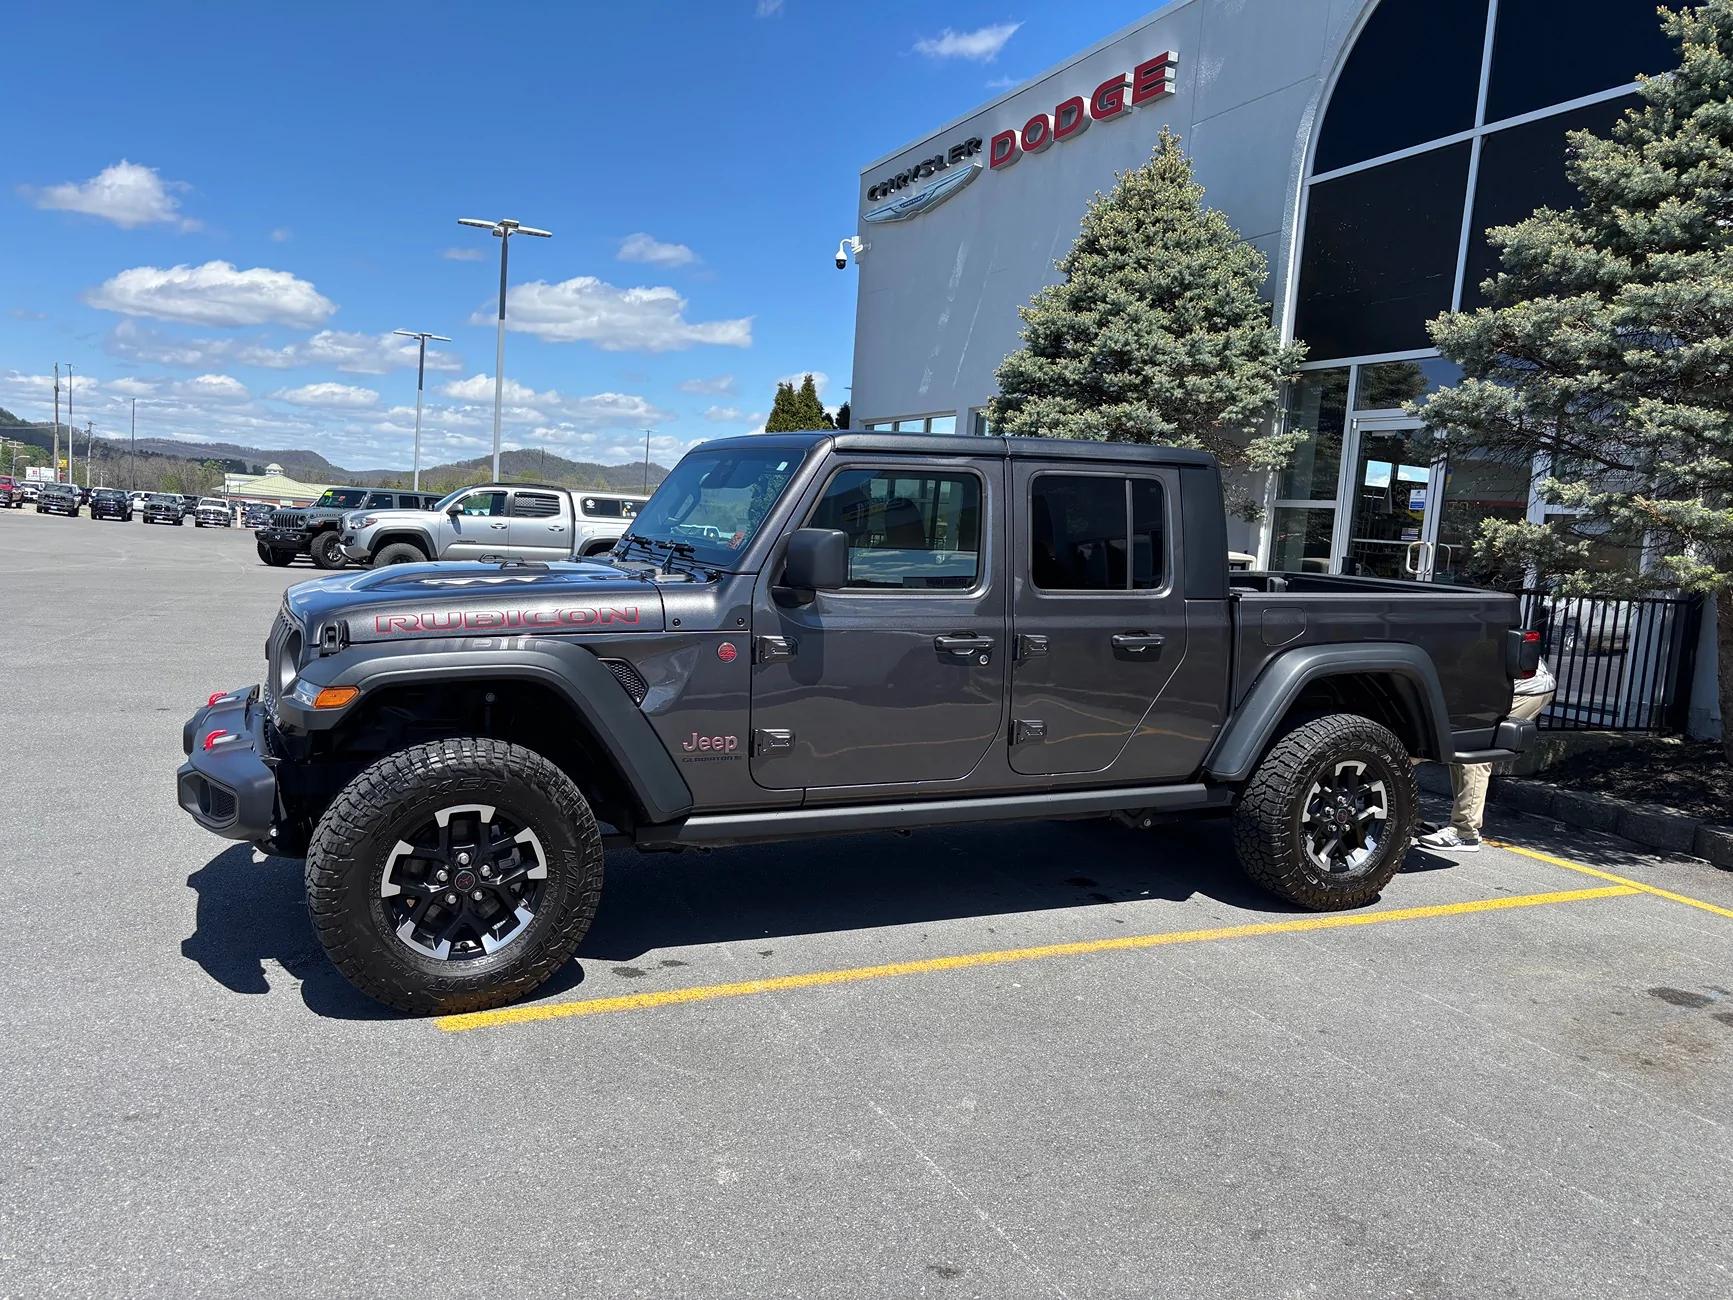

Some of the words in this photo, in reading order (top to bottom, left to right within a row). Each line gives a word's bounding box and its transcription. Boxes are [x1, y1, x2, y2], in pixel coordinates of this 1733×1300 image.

[989, 50, 1179, 170] DODGE
[867, 137, 983, 202] CHRYSLER
[375, 606, 639, 633] RUBICON
[682, 732, 738, 754] Jeep
[682, 755, 733, 763] GLADIATOR
